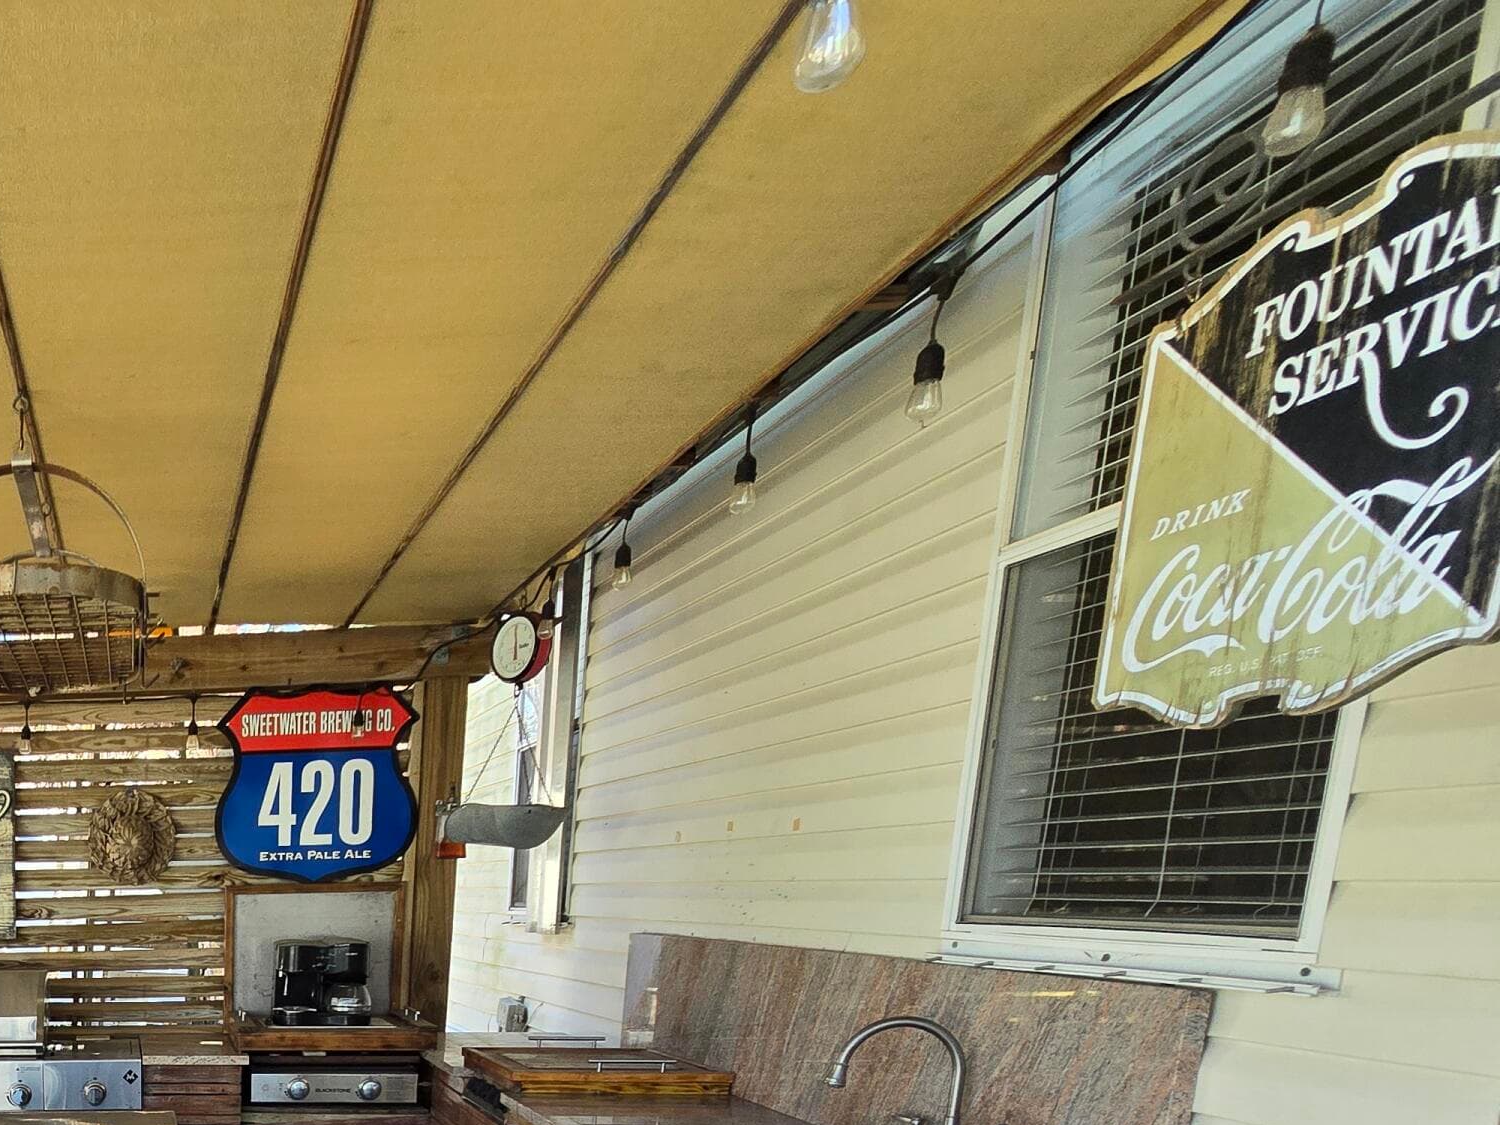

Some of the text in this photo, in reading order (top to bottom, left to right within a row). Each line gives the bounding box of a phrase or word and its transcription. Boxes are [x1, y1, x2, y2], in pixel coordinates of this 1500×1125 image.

[1150, 488, 1251, 541] DRINK
[1122, 454, 1500, 673] Coca-Cola
[241, 708, 395, 737] SWEETWATER BREWG CO.
[258, 758, 375, 847] 420
[260, 849, 371, 861] EXTRA PALE ALE
